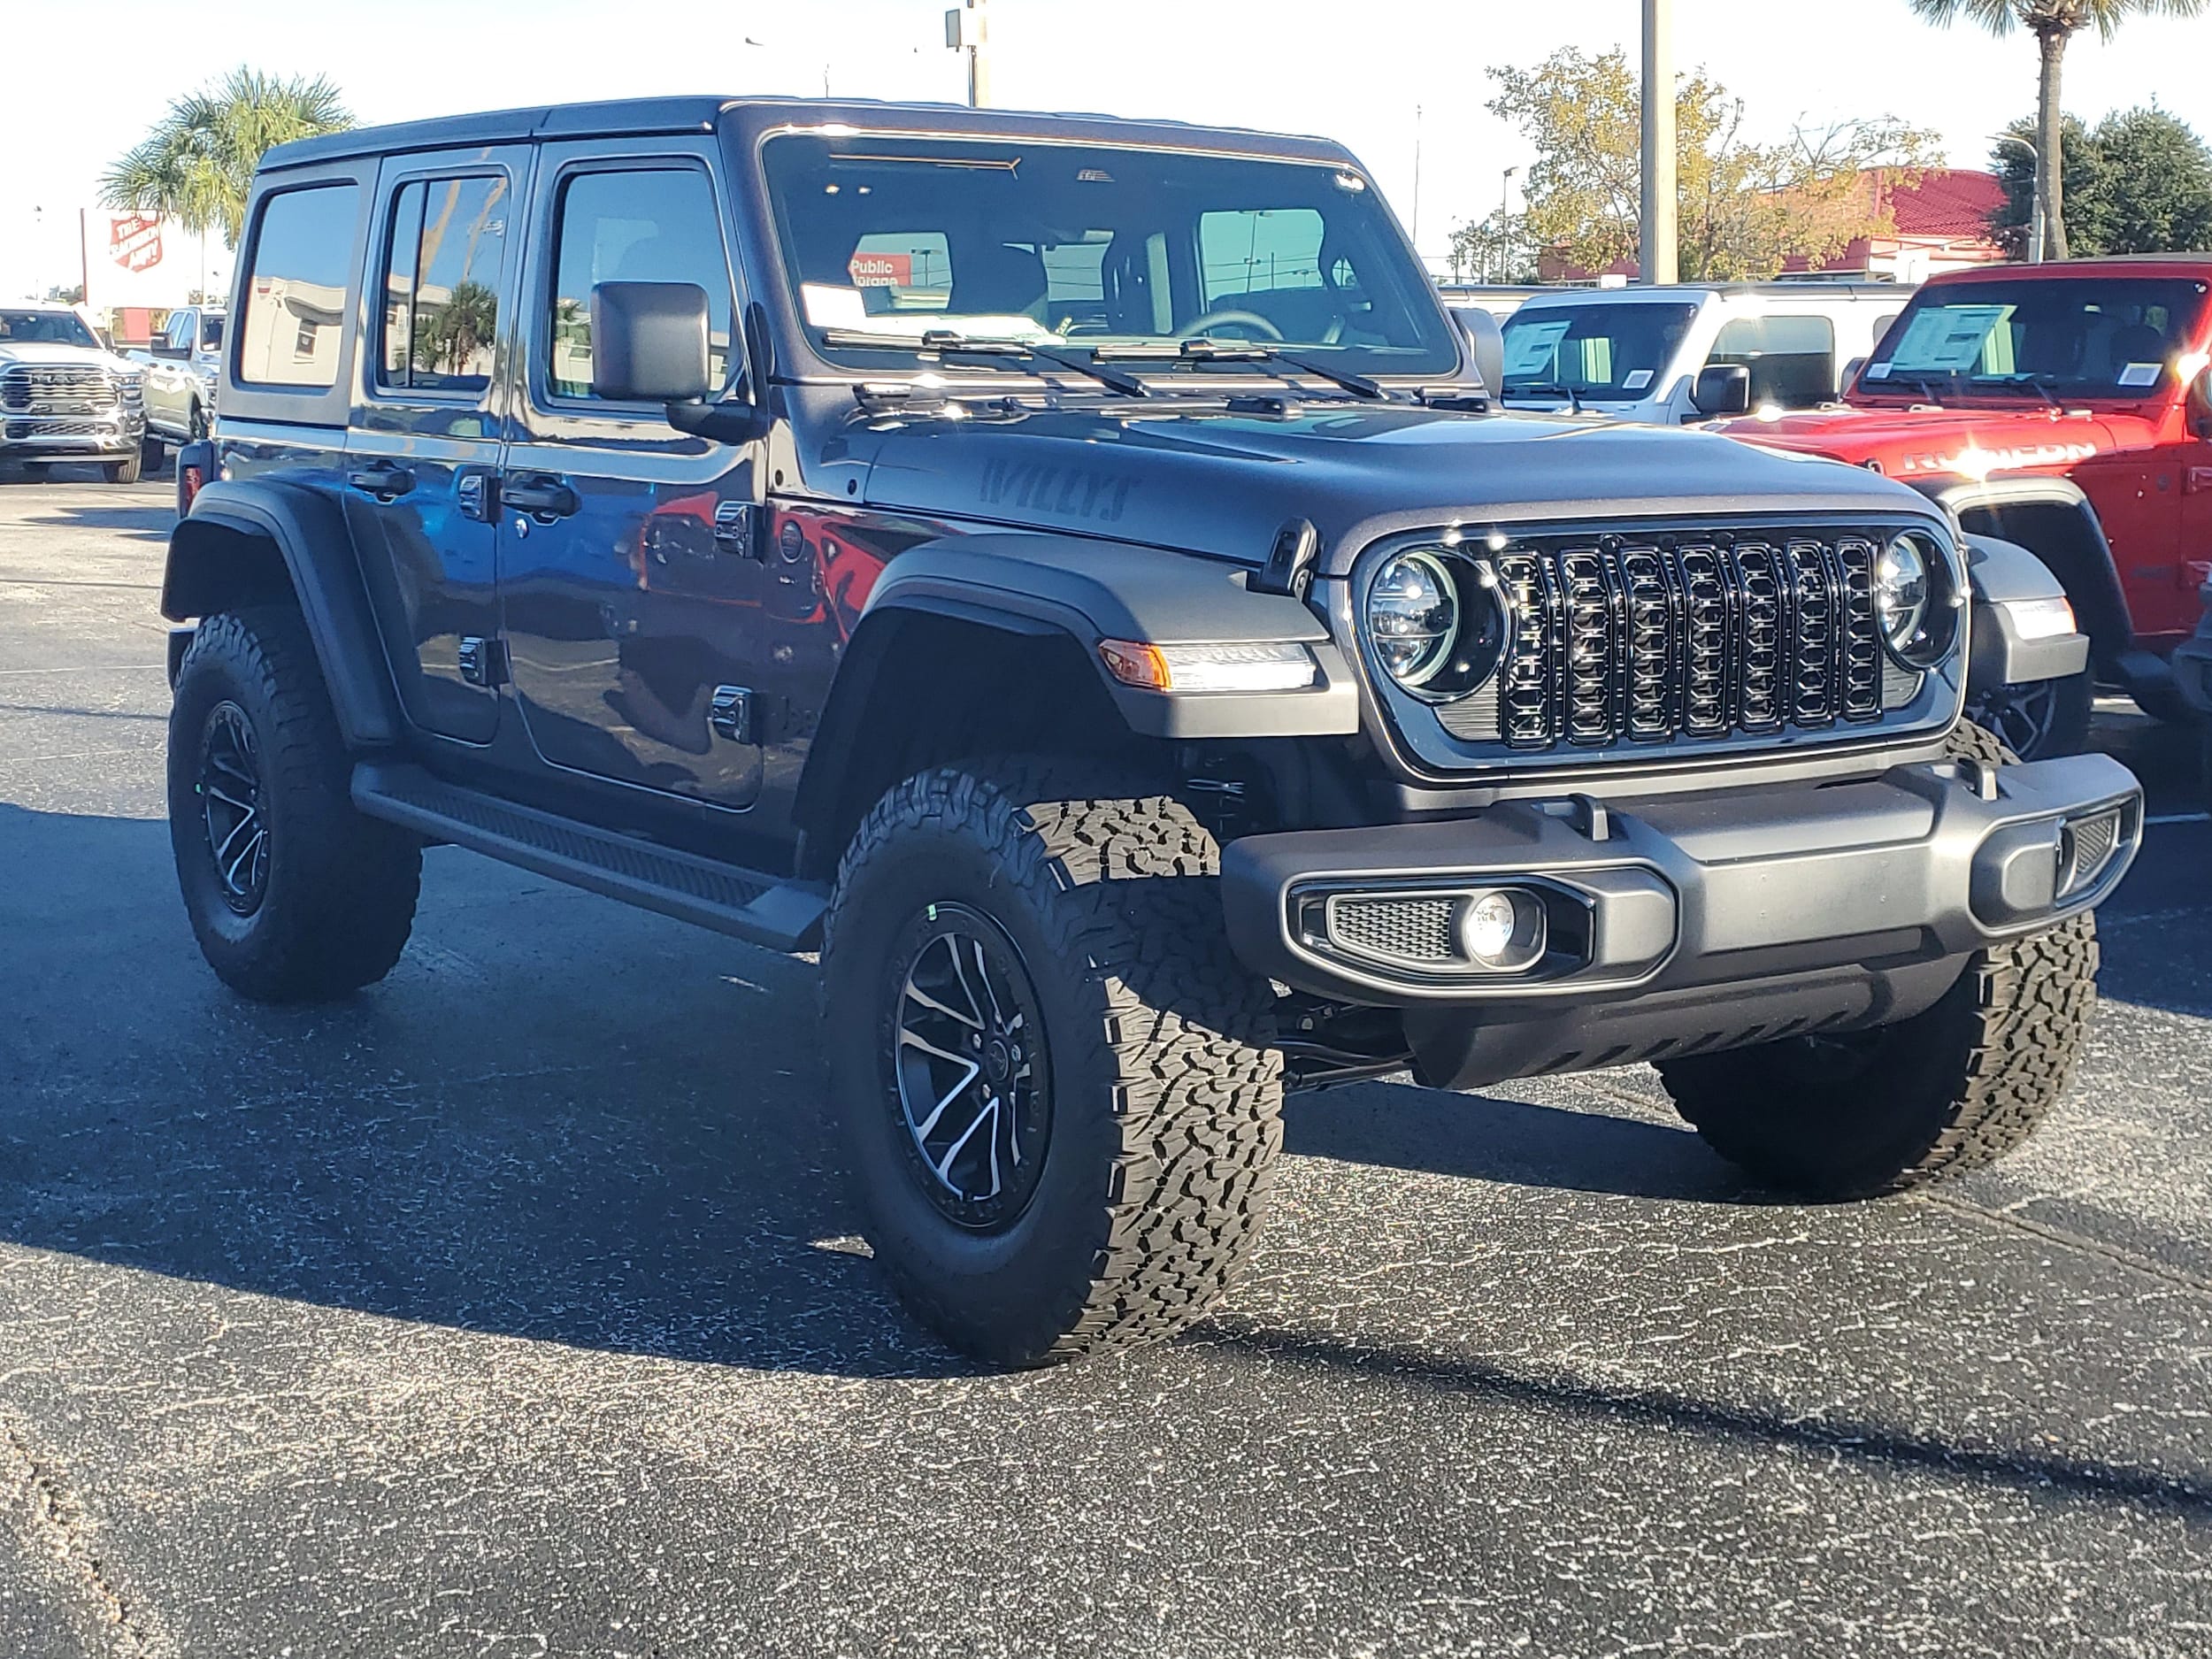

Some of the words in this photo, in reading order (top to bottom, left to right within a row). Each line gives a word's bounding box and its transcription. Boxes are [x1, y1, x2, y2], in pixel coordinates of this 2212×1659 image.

[850, 259, 894, 274] Public
[1903, 442, 2097, 471] RUICON
[979, 457, 1147, 522] WILLYS
